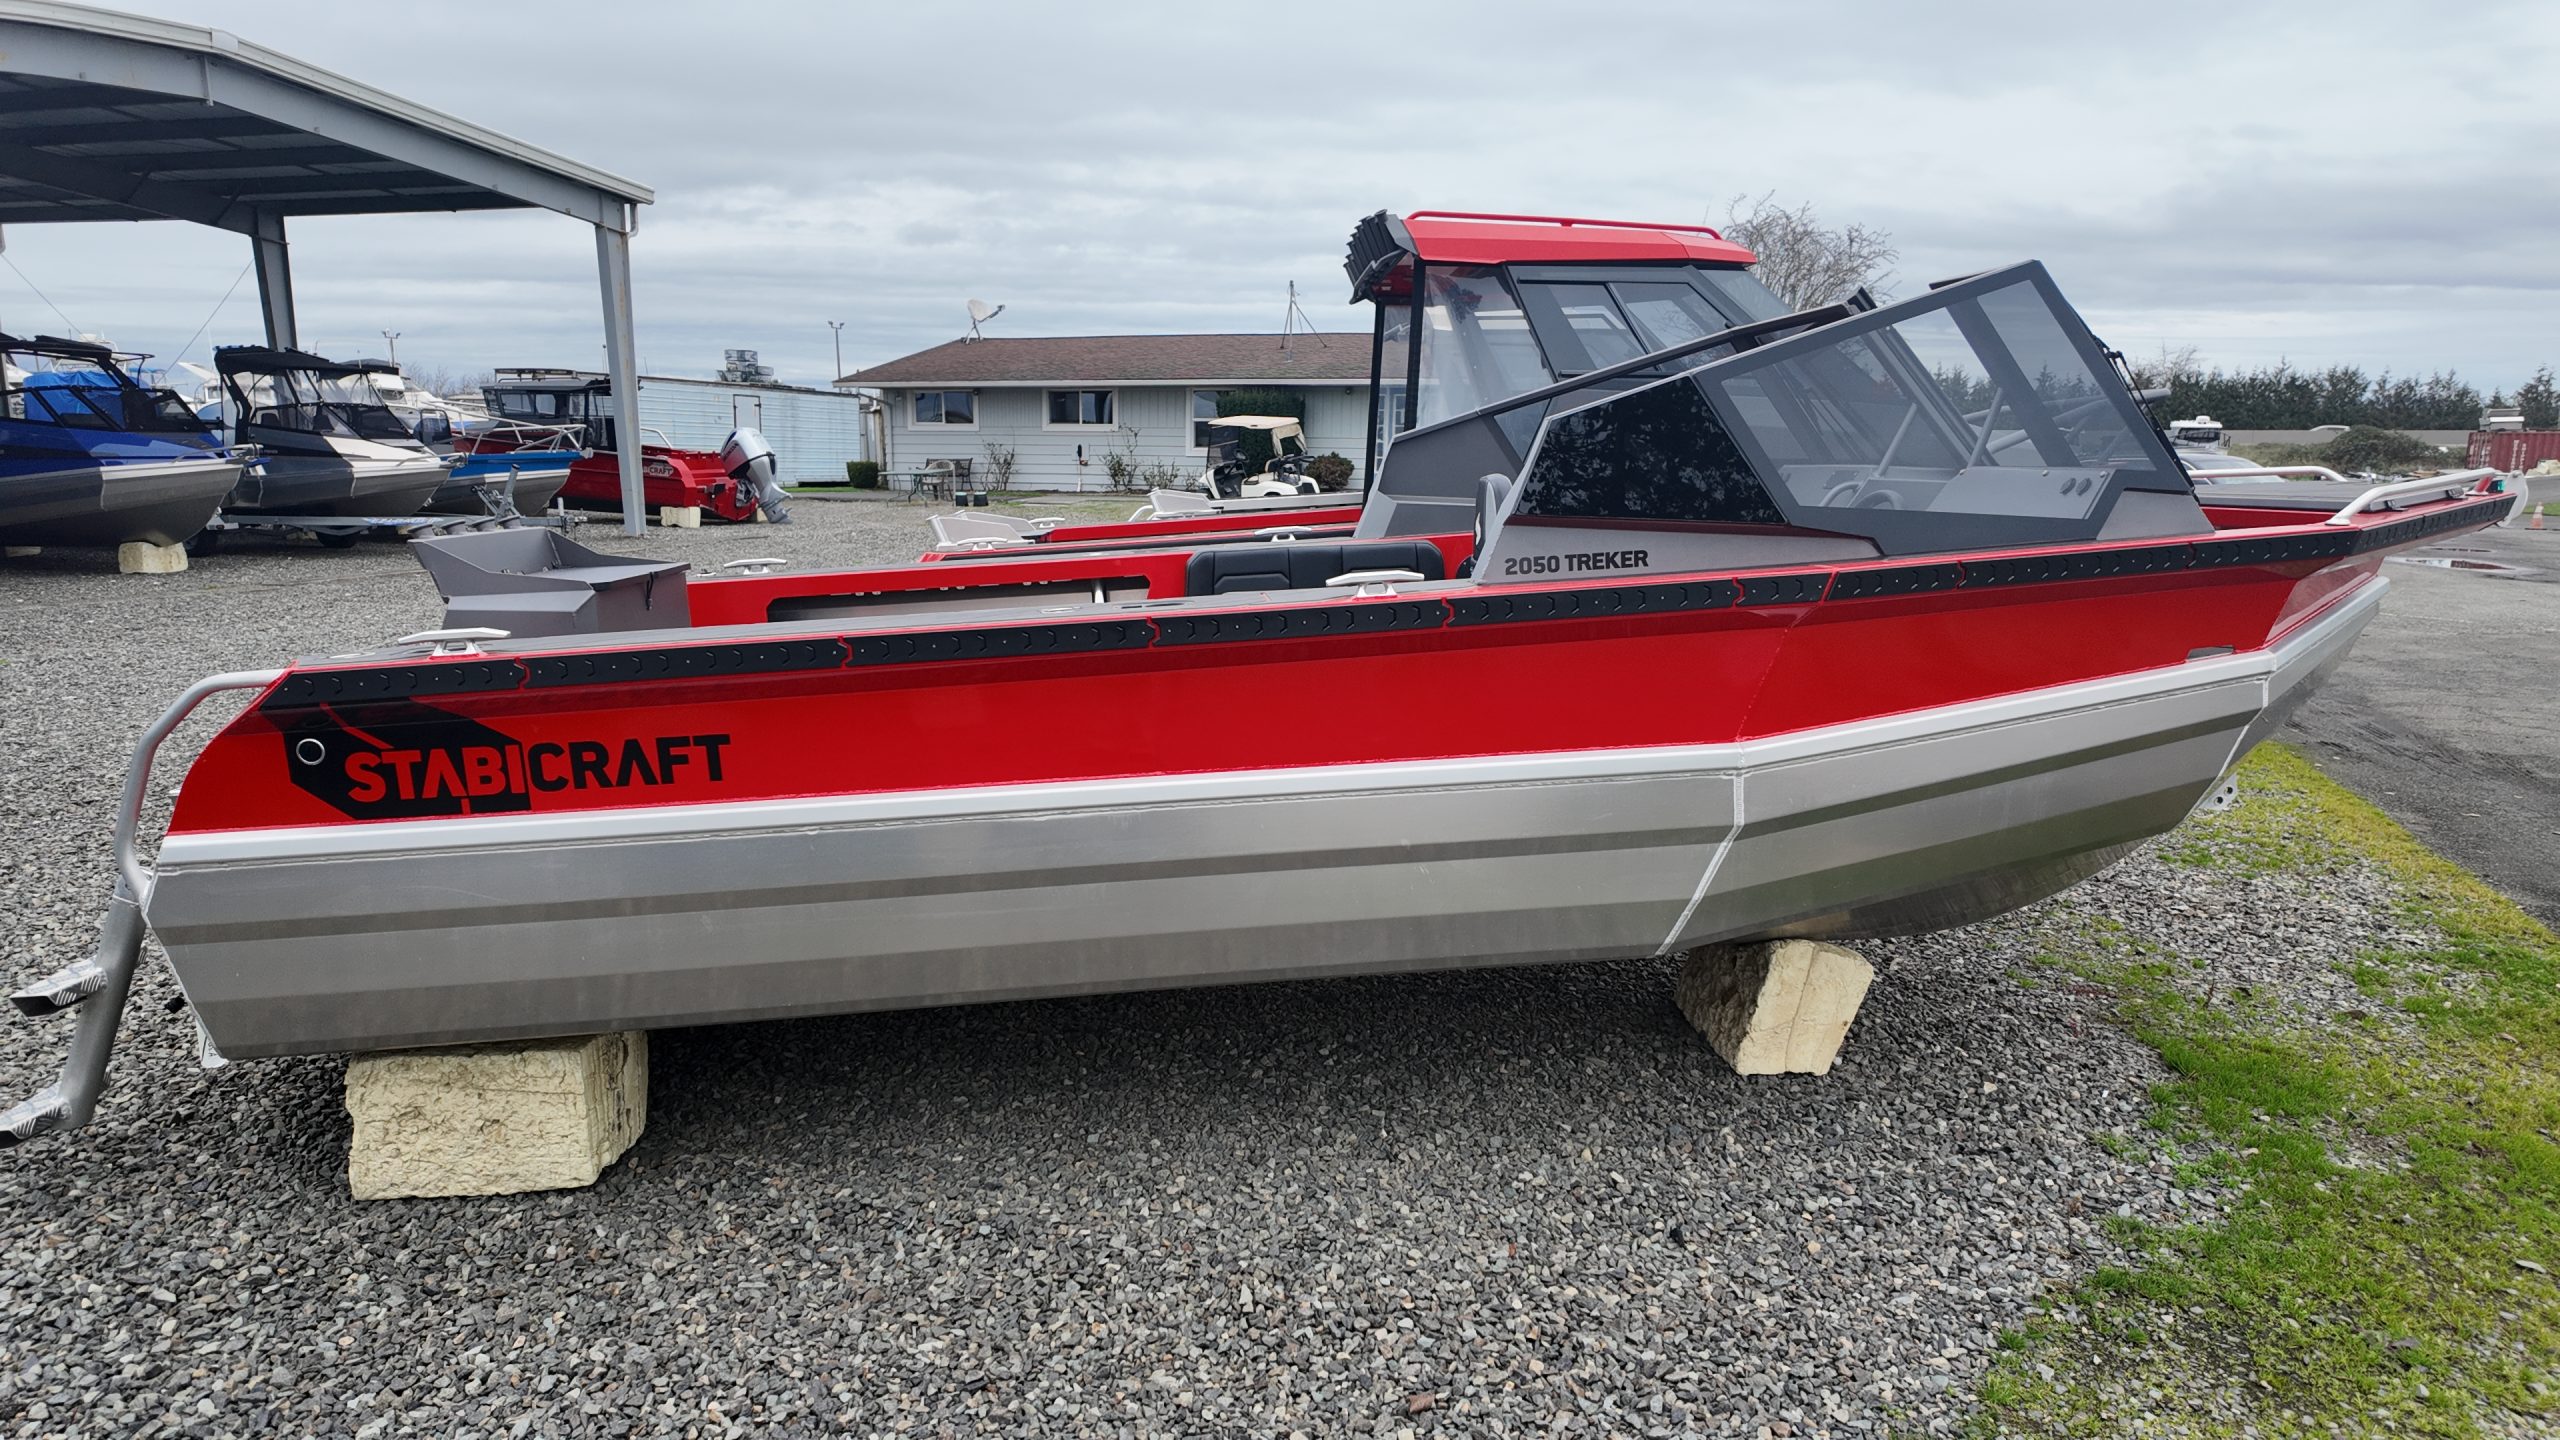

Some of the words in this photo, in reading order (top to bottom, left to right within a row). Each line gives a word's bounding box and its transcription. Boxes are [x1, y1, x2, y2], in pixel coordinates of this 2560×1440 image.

[1504, 555, 1560, 575] 2050
[1564, 550, 1649, 572] TREKER
[345, 735, 731, 803] STABICRAFT
